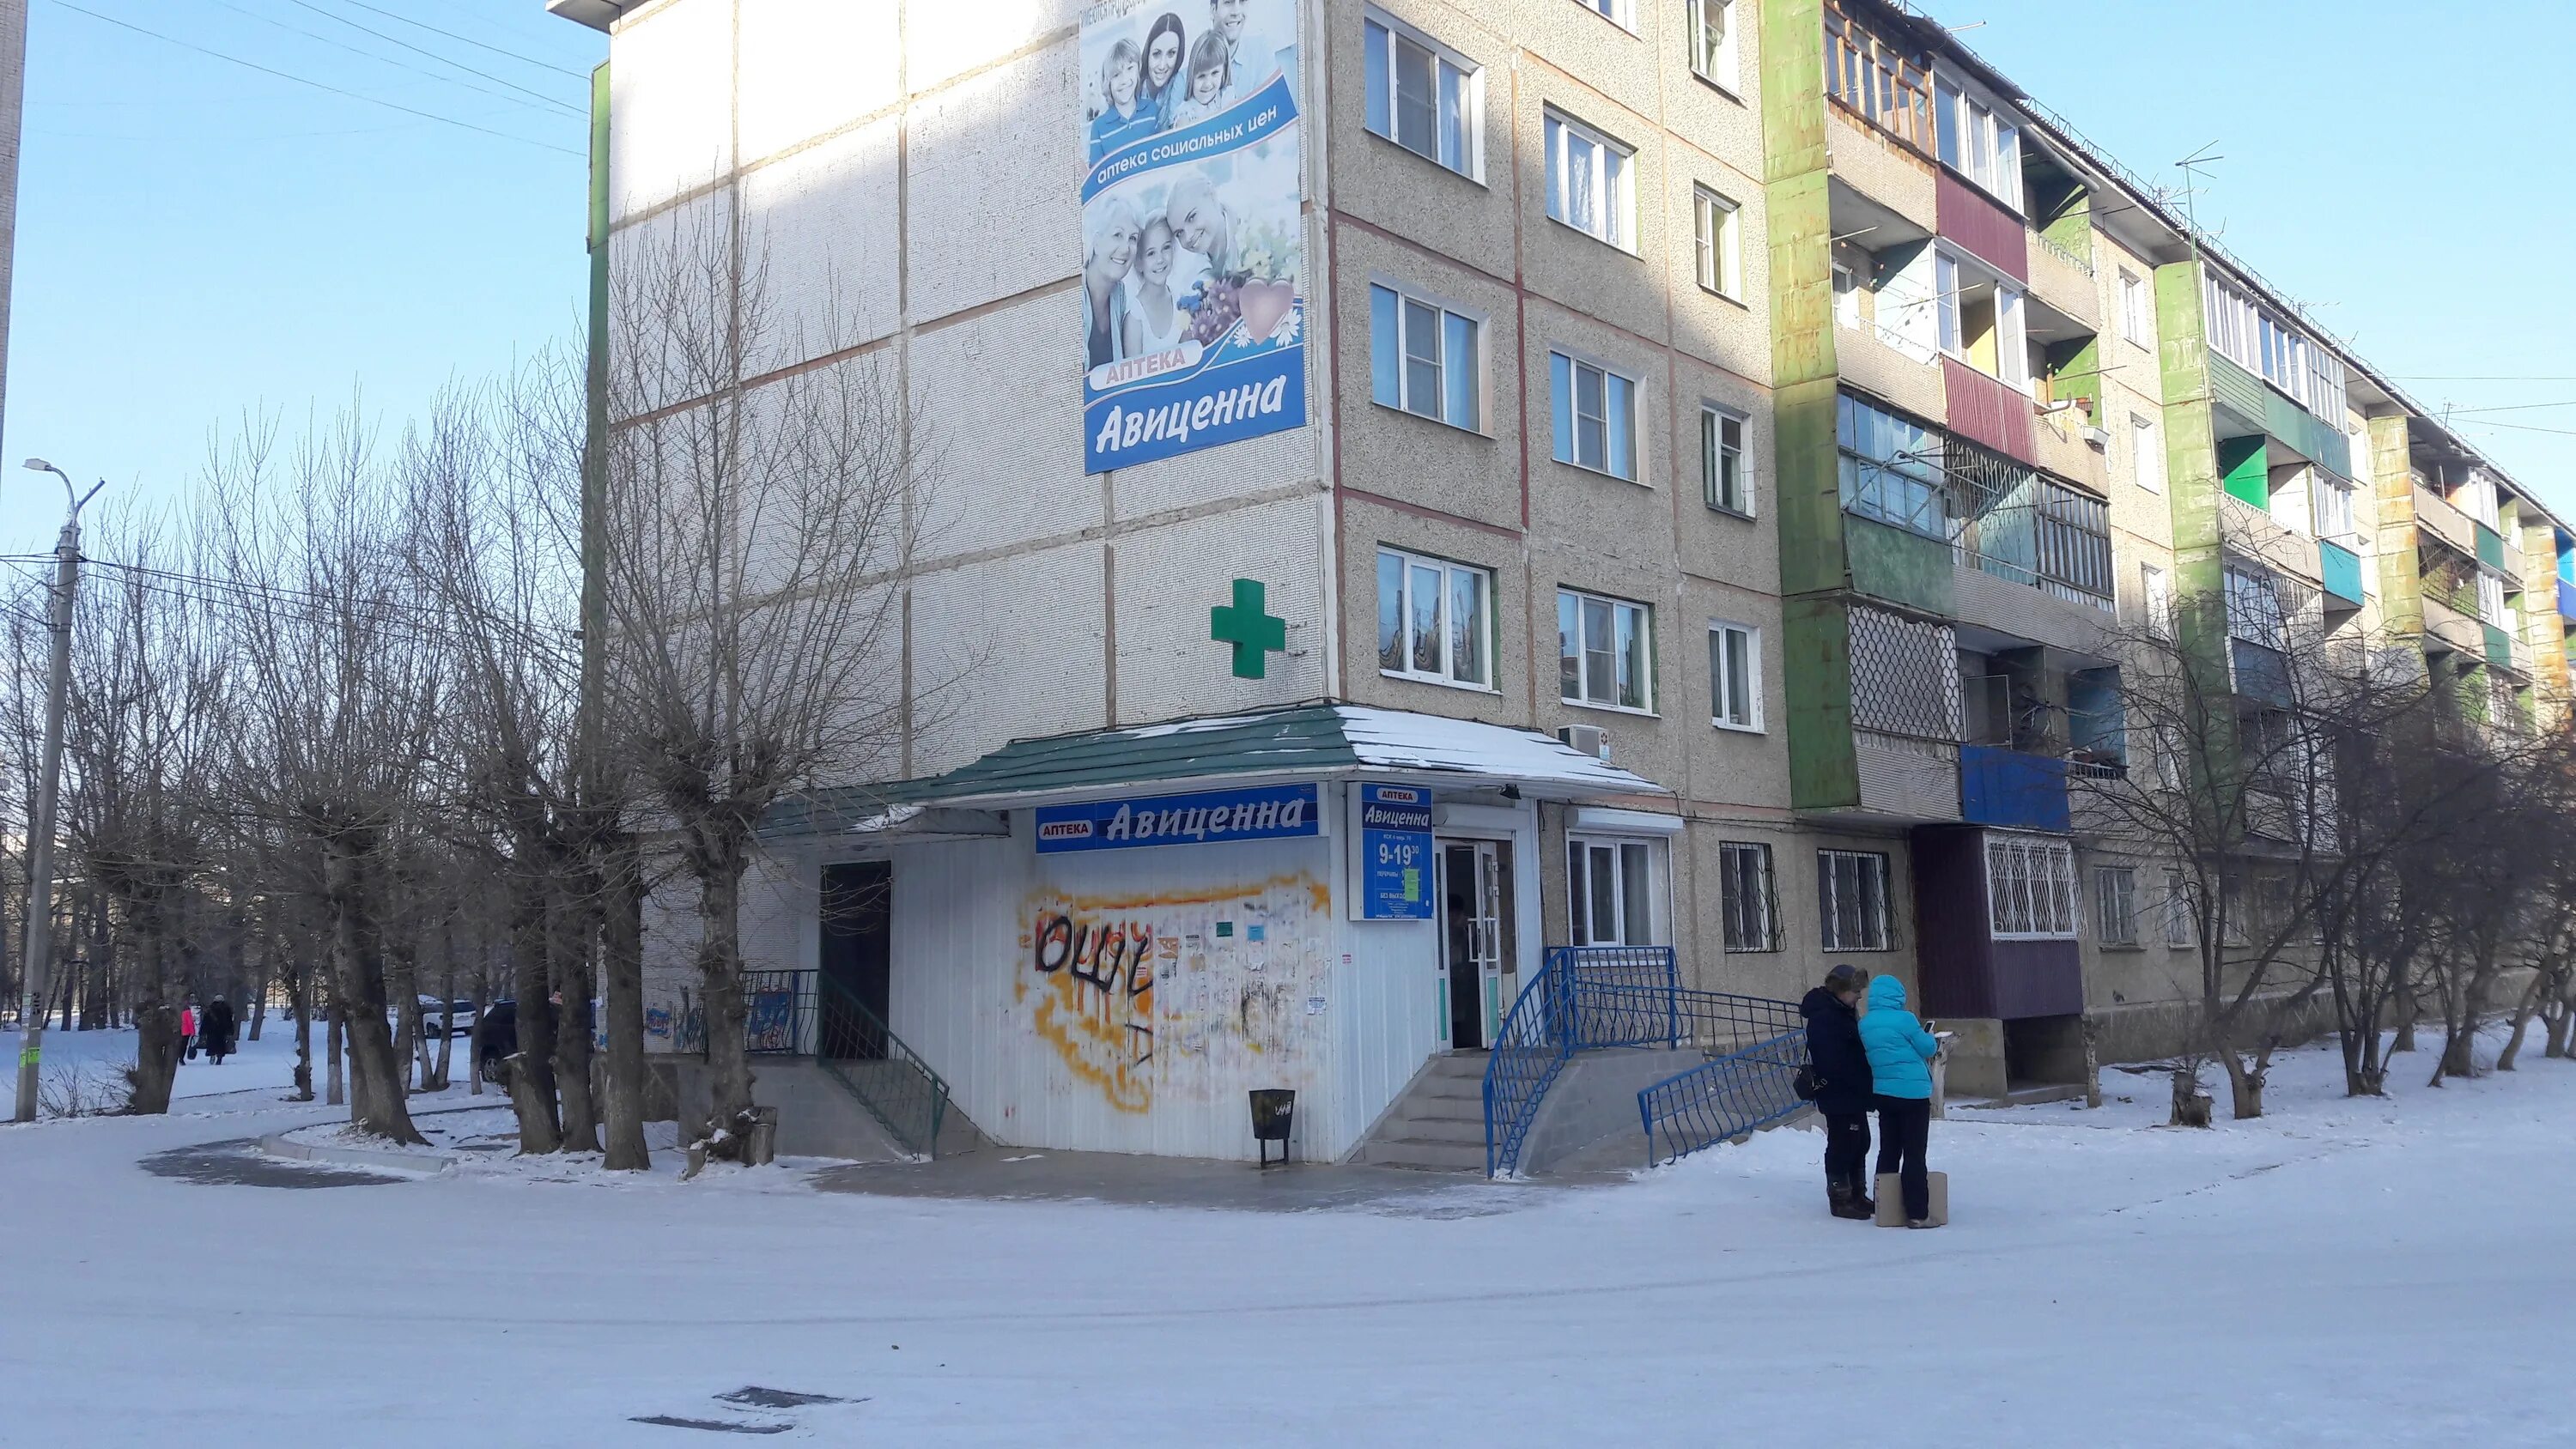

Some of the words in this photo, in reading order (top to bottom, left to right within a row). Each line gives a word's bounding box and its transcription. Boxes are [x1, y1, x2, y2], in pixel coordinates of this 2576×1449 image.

[1097, 150, 1147, 185] аптека
[1151, 122, 1243, 162] социальных
[1247, 104, 1278, 134] цен
[1105, 347, 1187, 385] АПТЕКА
[1095, 374, 1287, 453] Авиценна
[1365, 804, 1430, 828] Авиценна
[1382, 790, 1413, 801] АПТЕКА
[1042, 822, 1089, 837] АПТЕКА
[1106, 797, 1305, 841] Авиценна
